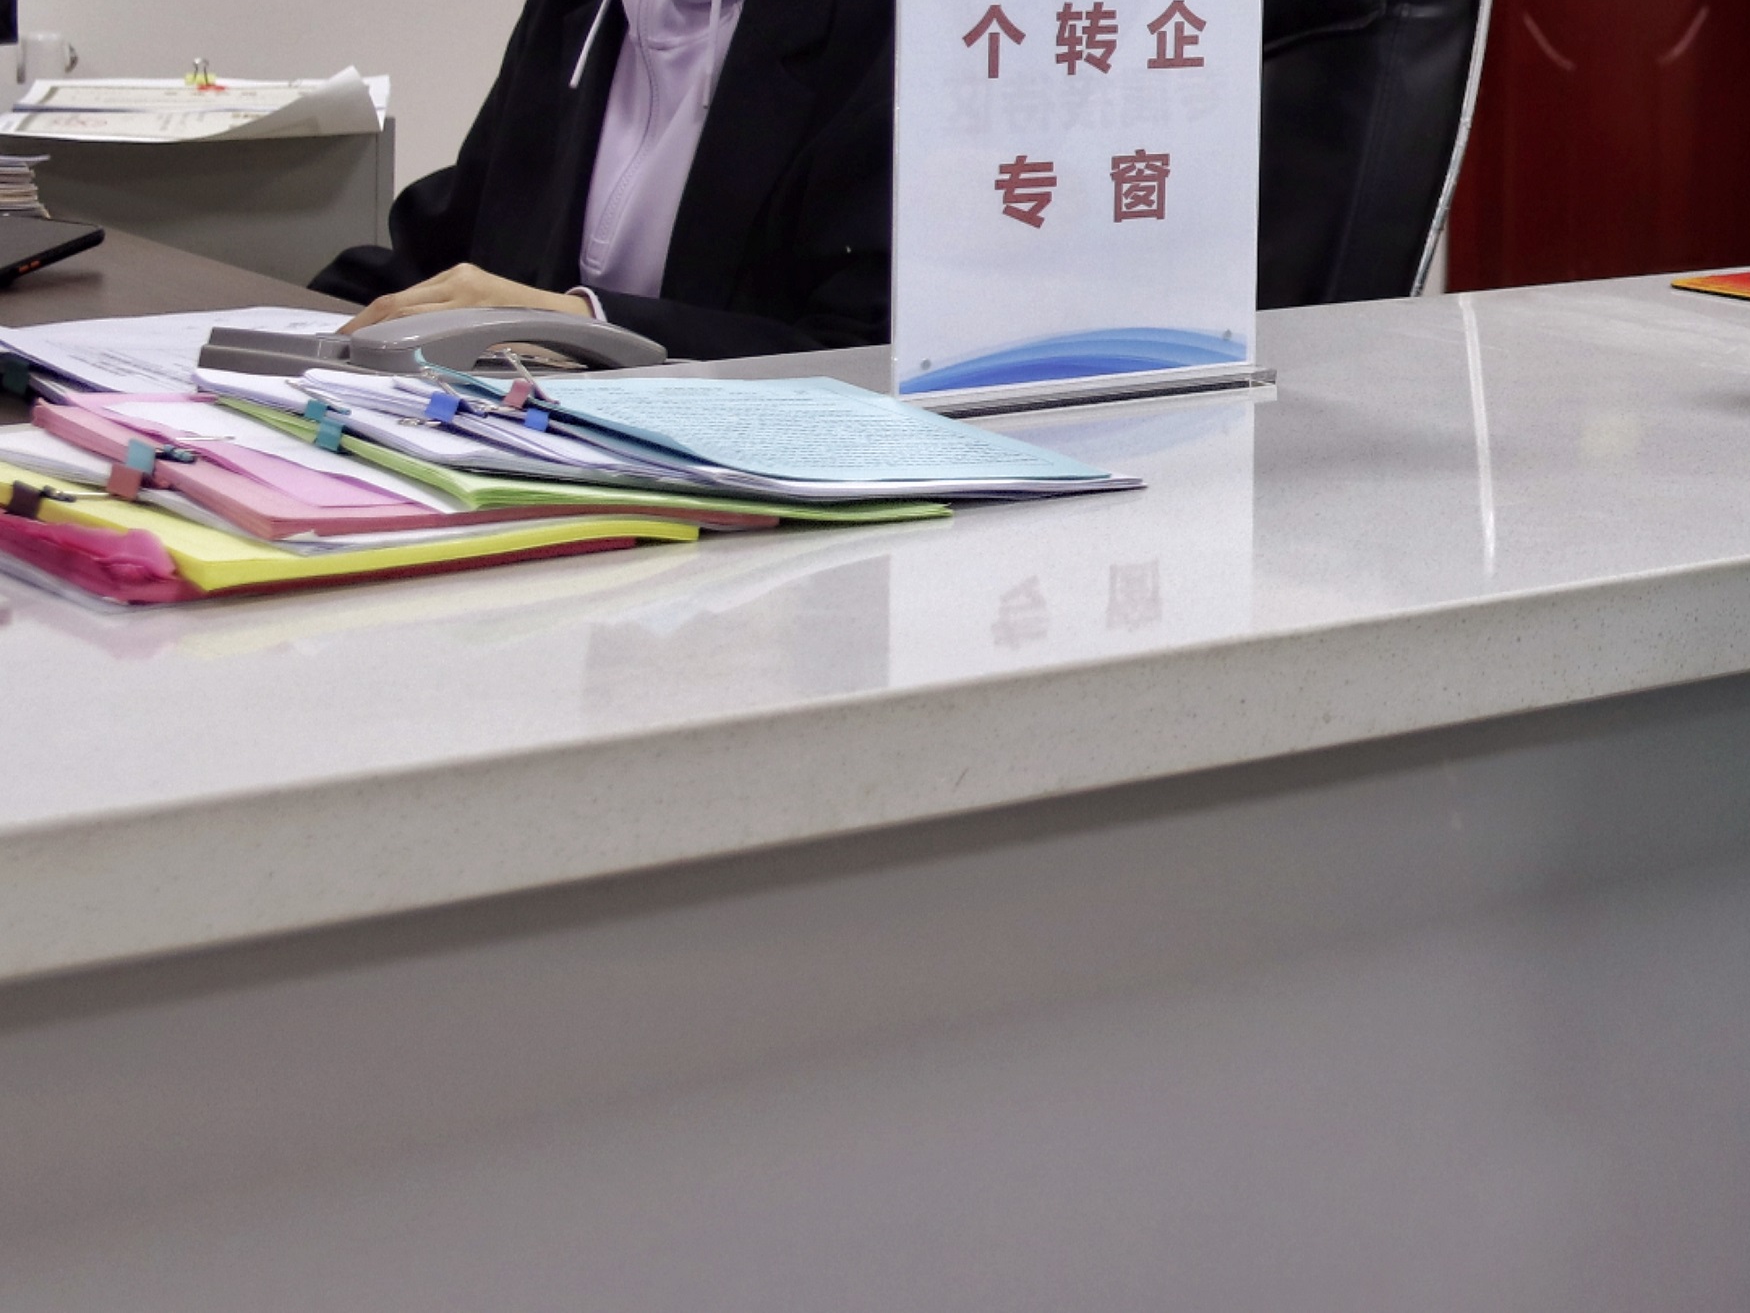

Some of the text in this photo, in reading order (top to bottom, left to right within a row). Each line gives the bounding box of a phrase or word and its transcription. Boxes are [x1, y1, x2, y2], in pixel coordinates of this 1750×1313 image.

[962, 0, 1206, 78] 个转企
[994, 149, 1171, 228] 专窗
